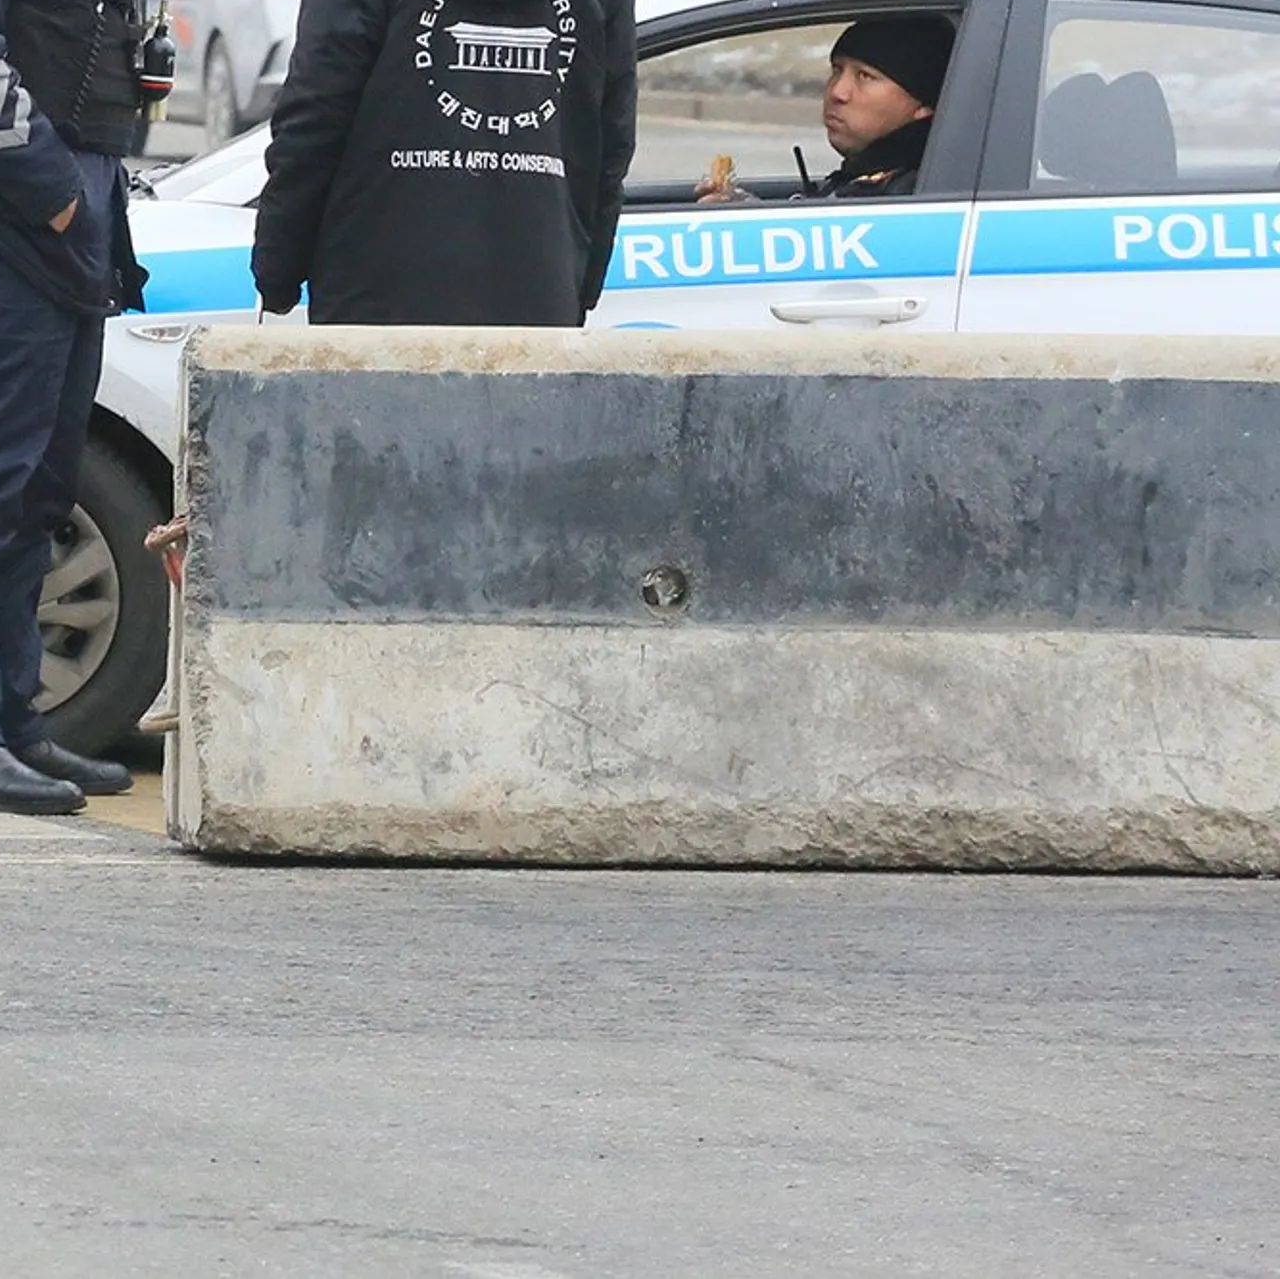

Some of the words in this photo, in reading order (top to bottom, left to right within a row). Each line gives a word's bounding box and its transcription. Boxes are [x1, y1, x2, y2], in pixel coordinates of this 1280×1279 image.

[390, 149, 451, 169] CULTURE
[452, 149, 464, 169] &
[465, 150, 500, 170] ARTS
[615, 222, 880, 280] RÚLDIK
[1112, 211, 1280, 260] POLI
